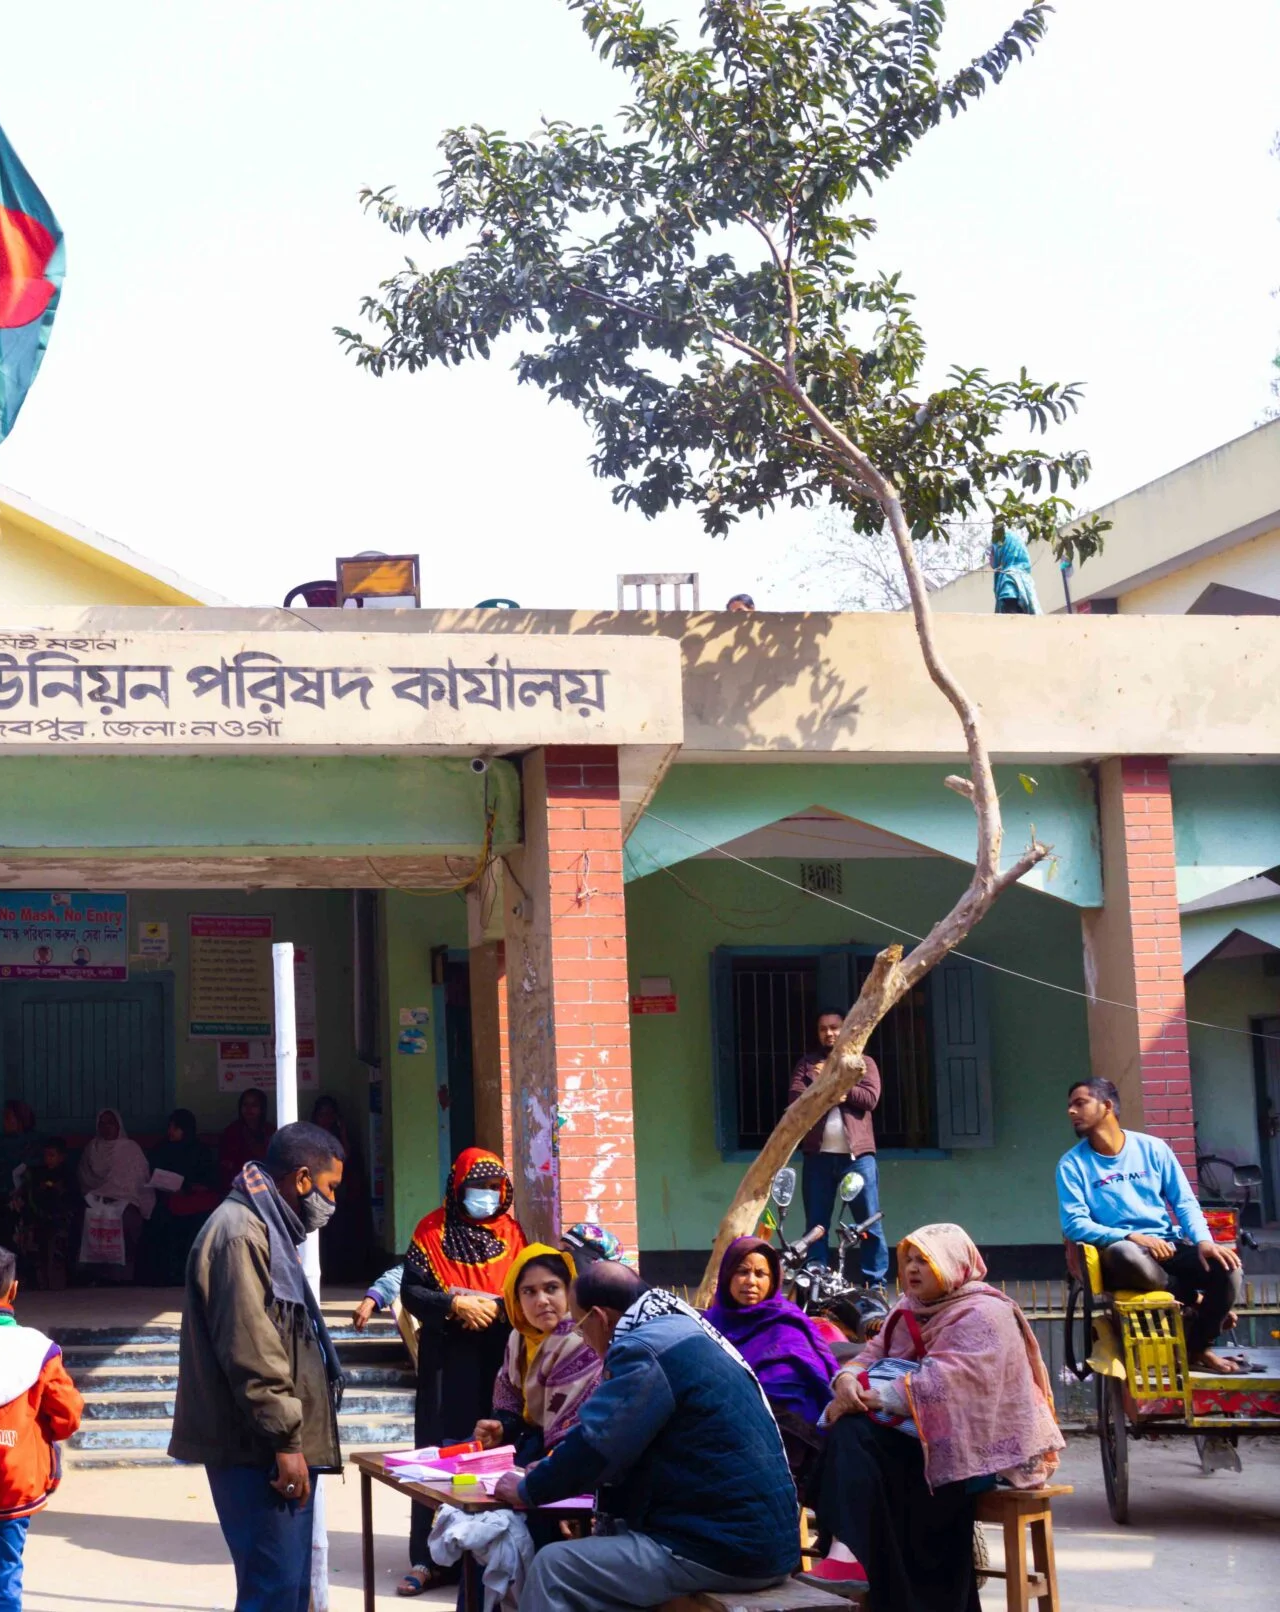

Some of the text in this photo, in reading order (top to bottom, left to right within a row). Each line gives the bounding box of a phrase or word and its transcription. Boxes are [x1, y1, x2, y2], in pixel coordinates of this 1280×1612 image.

[186, 651, 374, 714] পরিষদ
[388, 652, 611, 718] কার্যালয়
[20, 906, 61, 924] Mask,
[64, 907, 87, 922] No
[87, 907, 123, 926] Entry
